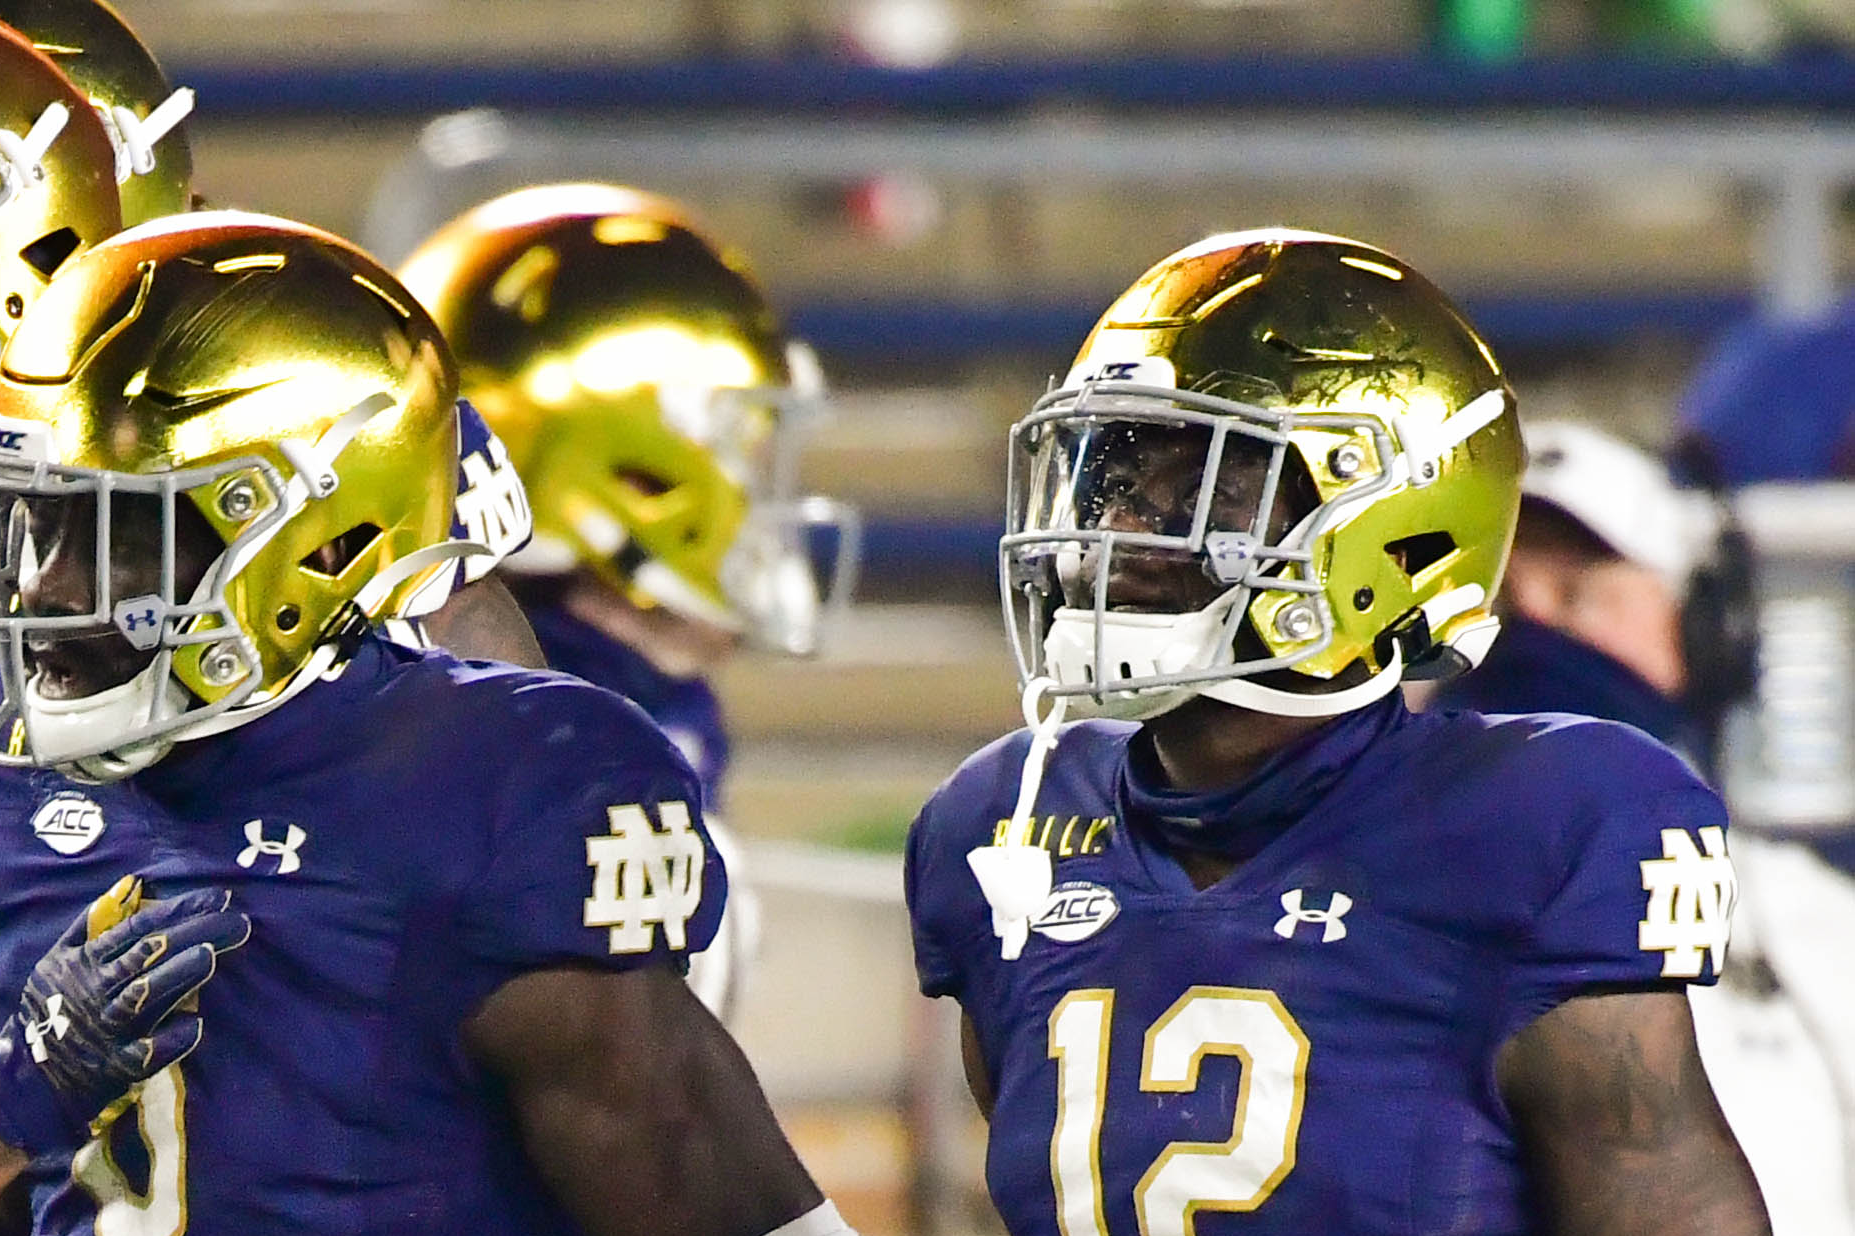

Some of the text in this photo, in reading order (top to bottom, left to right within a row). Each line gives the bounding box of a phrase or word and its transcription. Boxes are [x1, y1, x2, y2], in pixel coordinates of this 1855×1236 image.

[43, 809, 97, 831] ACC
[583, 800, 706, 954] ND
[1040, 895, 1108, 921] ACC
